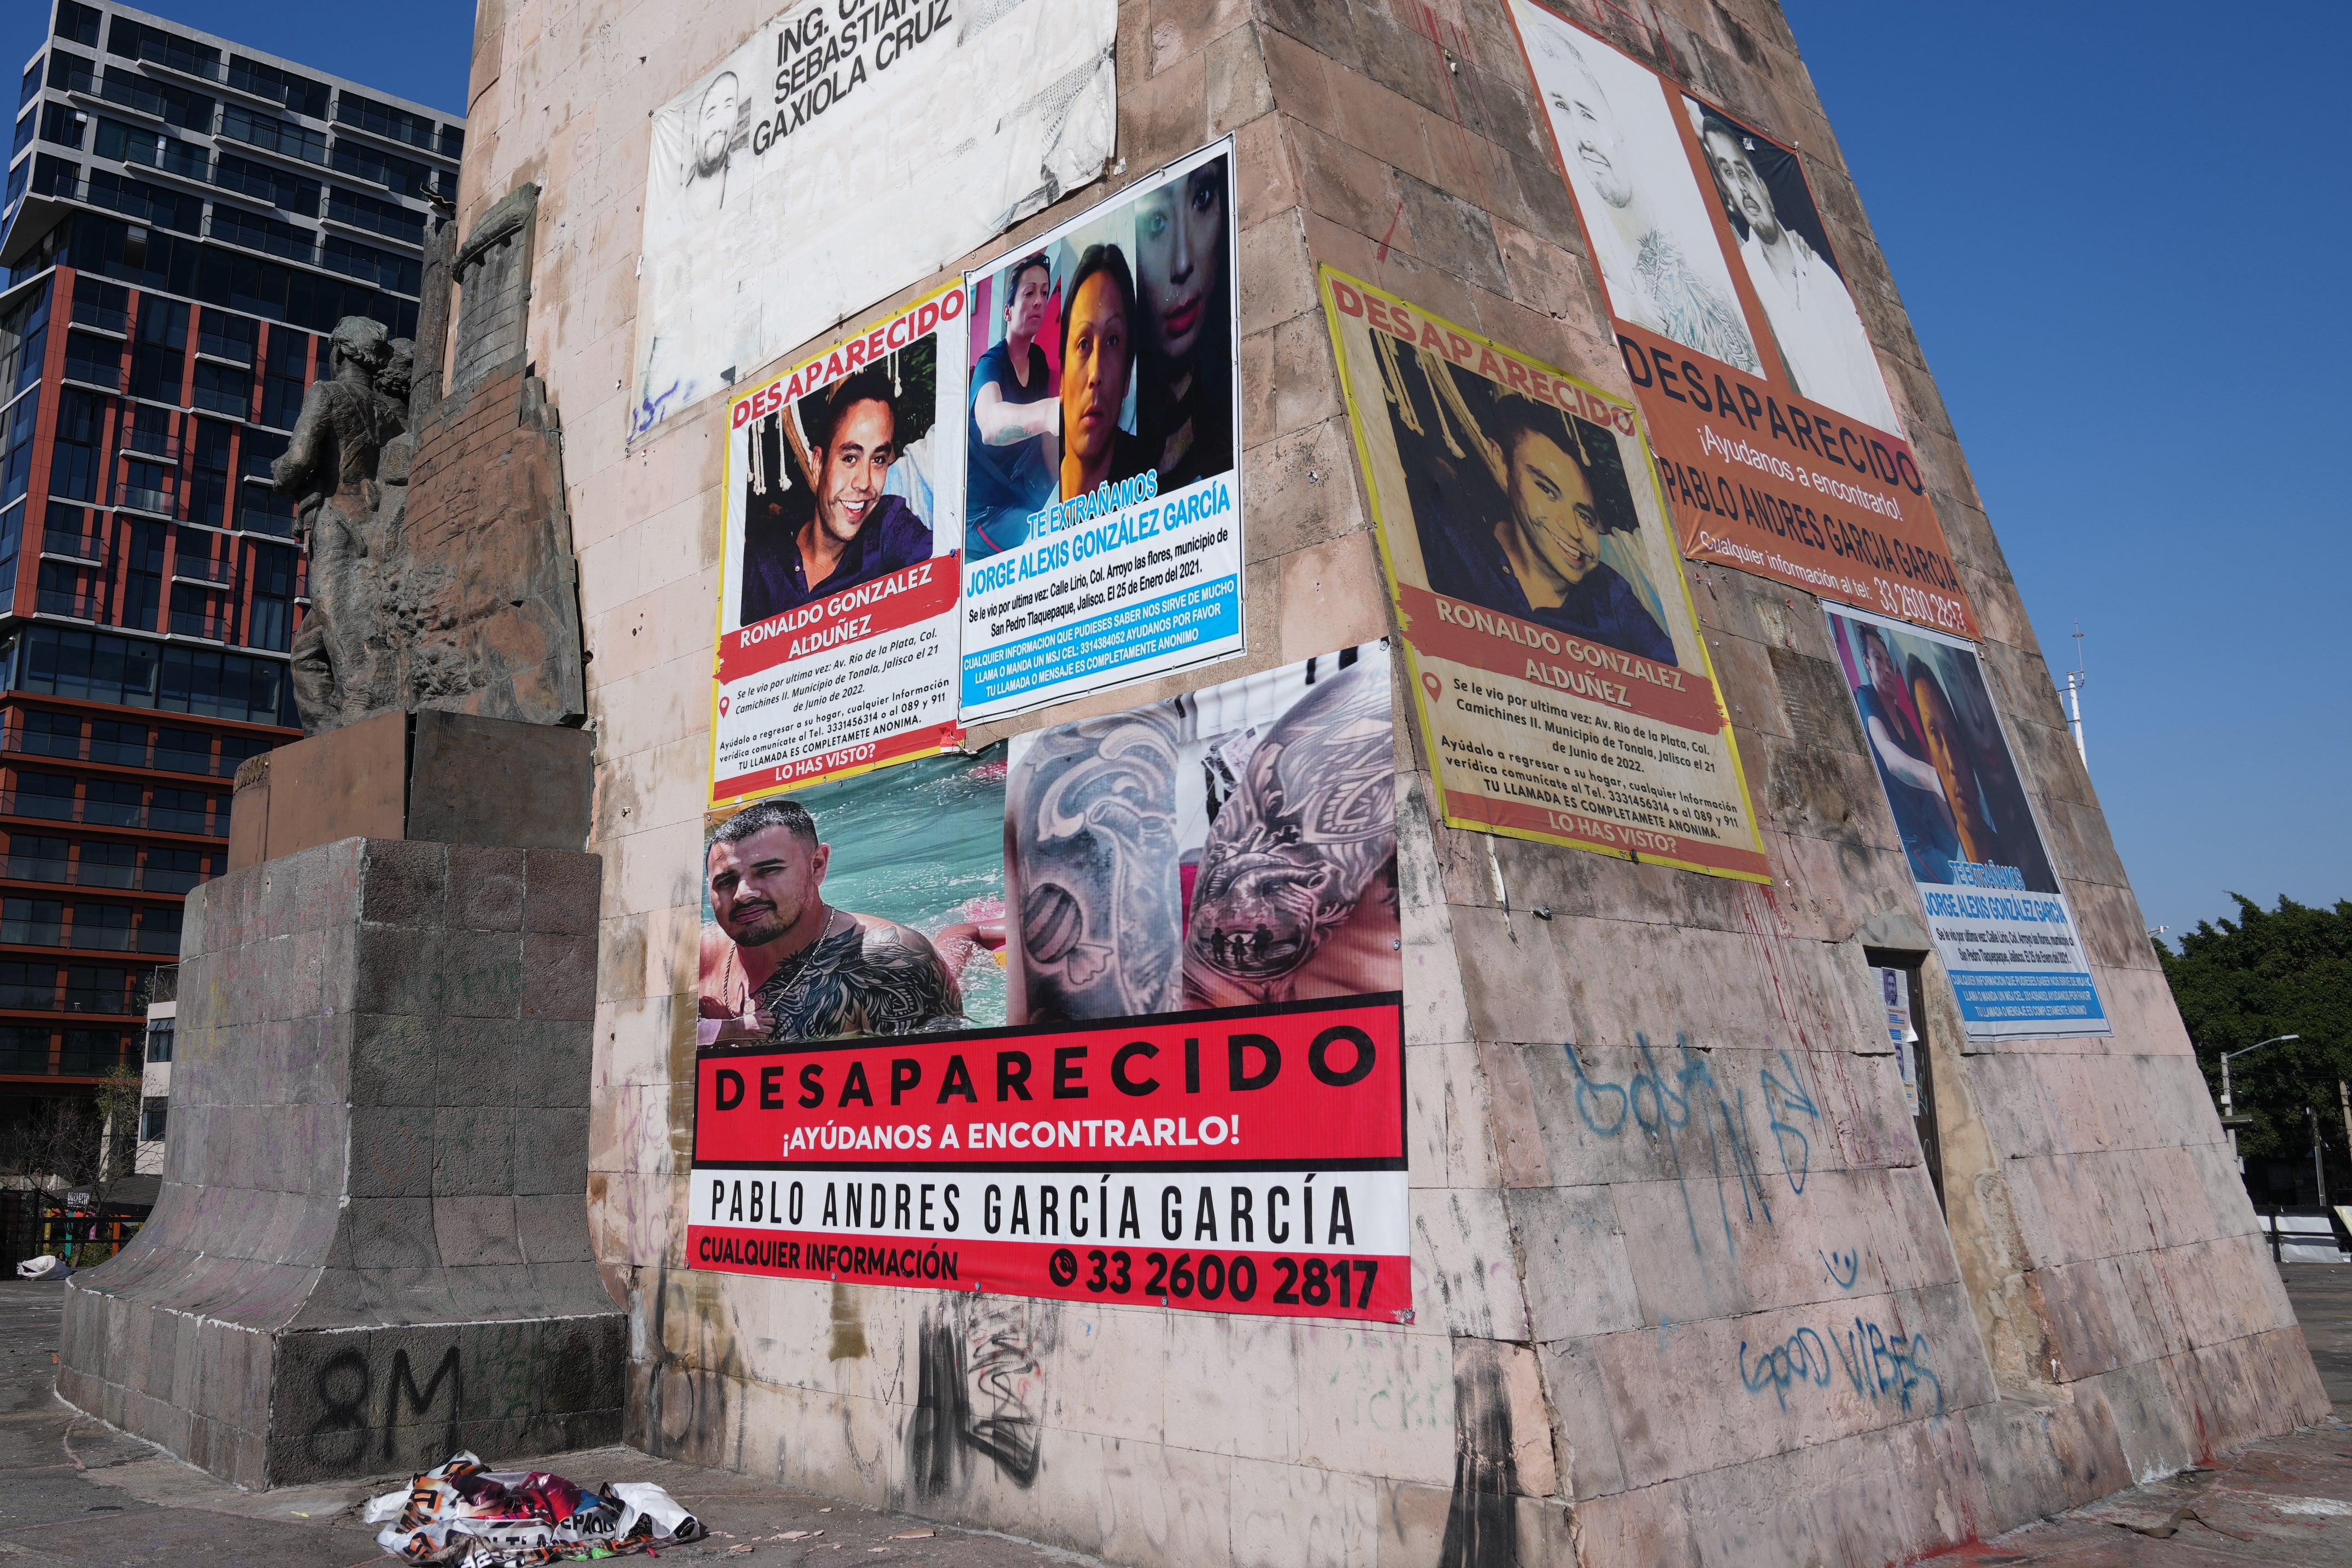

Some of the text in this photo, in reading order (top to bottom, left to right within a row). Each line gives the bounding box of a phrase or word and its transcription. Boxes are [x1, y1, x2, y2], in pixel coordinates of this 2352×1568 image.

[778, 7, 829, 67] ING.
[753, 0, 952, 156] GAXIOLA CRUZ
[731, 289, 965, 430] DESAPARECIDO
[1332, 279, 1635, 437] DESAPARECIDO
[1616, 333, 1922, 496] DESAPARECIDO
[1027, 469, 1157, 539] TE EXTRAÑAMOS
[1697, 425, 1903, 521] ¡Ayudanos a encontrarlo!
[967, 481, 1230, 598] JORGE ALEXIS GONZÁLEZ GARCÍA
[1659, 456, 1963, 595] PABLO ANDRES GARCIA GARCIA
[741, 562, 933, 649] RONALDO GONZALEZ
[969, 528, 1228, 623] Se le vio por ultima vez: Calle Lirio, Col. Arroyo las flores, municipio de
[991, 559, 1203, 637] San Pedro Tlaquepaque, Jalisco. El 25 de Enero del 2021.
[1700, 531, 1966, 632] Cualquier información al tel: 33 2600 2817
[788, 614, 872, 659] ALDUÑEZ
[964, 579, 1235, 671] CUALQUIER INFORMACION QUE PUDIESES SABER NOS SIRVE DE MUCHO
[986, 627, 1199, 697] TU LLAMADA O MENSAJE ES COMPLETAMENTE ANONIMO
[1435, 598, 1686, 692] RONALDO GONZALEZ
[736, 695, 779, 715] Camichines
[791, 678, 832, 698] Municipio
[835, 674, 846, 685] de
[849, 664, 880, 680] Tonala,
[882, 654, 913, 673] Jalisco
[916, 648, 925, 660] el
[927, 644, 939, 656] 21
[737, 628, 937, 700] Se le vio por ultima vez: Av. Rio de la Plata, Col.
[793, 684, 865, 713] de Junio de 2022.
[1526, 658, 1632, 707] ALDUÑEZ
[775, 743, 876, 781] LO HAS VISTO?
[1441, 735, 1738, 813] Ayúdalo a regresar a su hogar, cualquier Información
[1445, 756, 1498, 775] verídica
[1501, 768, 1568, 790] comunícate
[1571, 782, 1582, 794] al
[1583, 784, 1605, 800] Tel.
[1608, 790, 1670, 813] 3331456314
[1682, 807, 1692, 818] al
[1693, 809, 1712, 823] 089
[1715, 817, 1721, 827] y
[1723, 815, 1739, 828] 911
[1483, 778, 1721, 839] TU LLAMADA ES COMPLETAMETE ANONIMA.
[1548, 811, 1676, 854] LO HAS VISTO?
[715, 1025, 1376, 1111] DESAPARECIDO
[783, 1114, 1240, 1157] ¡AYÚDANOS A ENCONTRARLO!
[712, 1173, 1355, 1247] PABLO ANDRES GARCÍA GARCÍA
[699, 1236, 958, 1281] CUALQUIER INFORMACIÓN
[1086, 1249, 1378, 1309] 33 2600 2817
